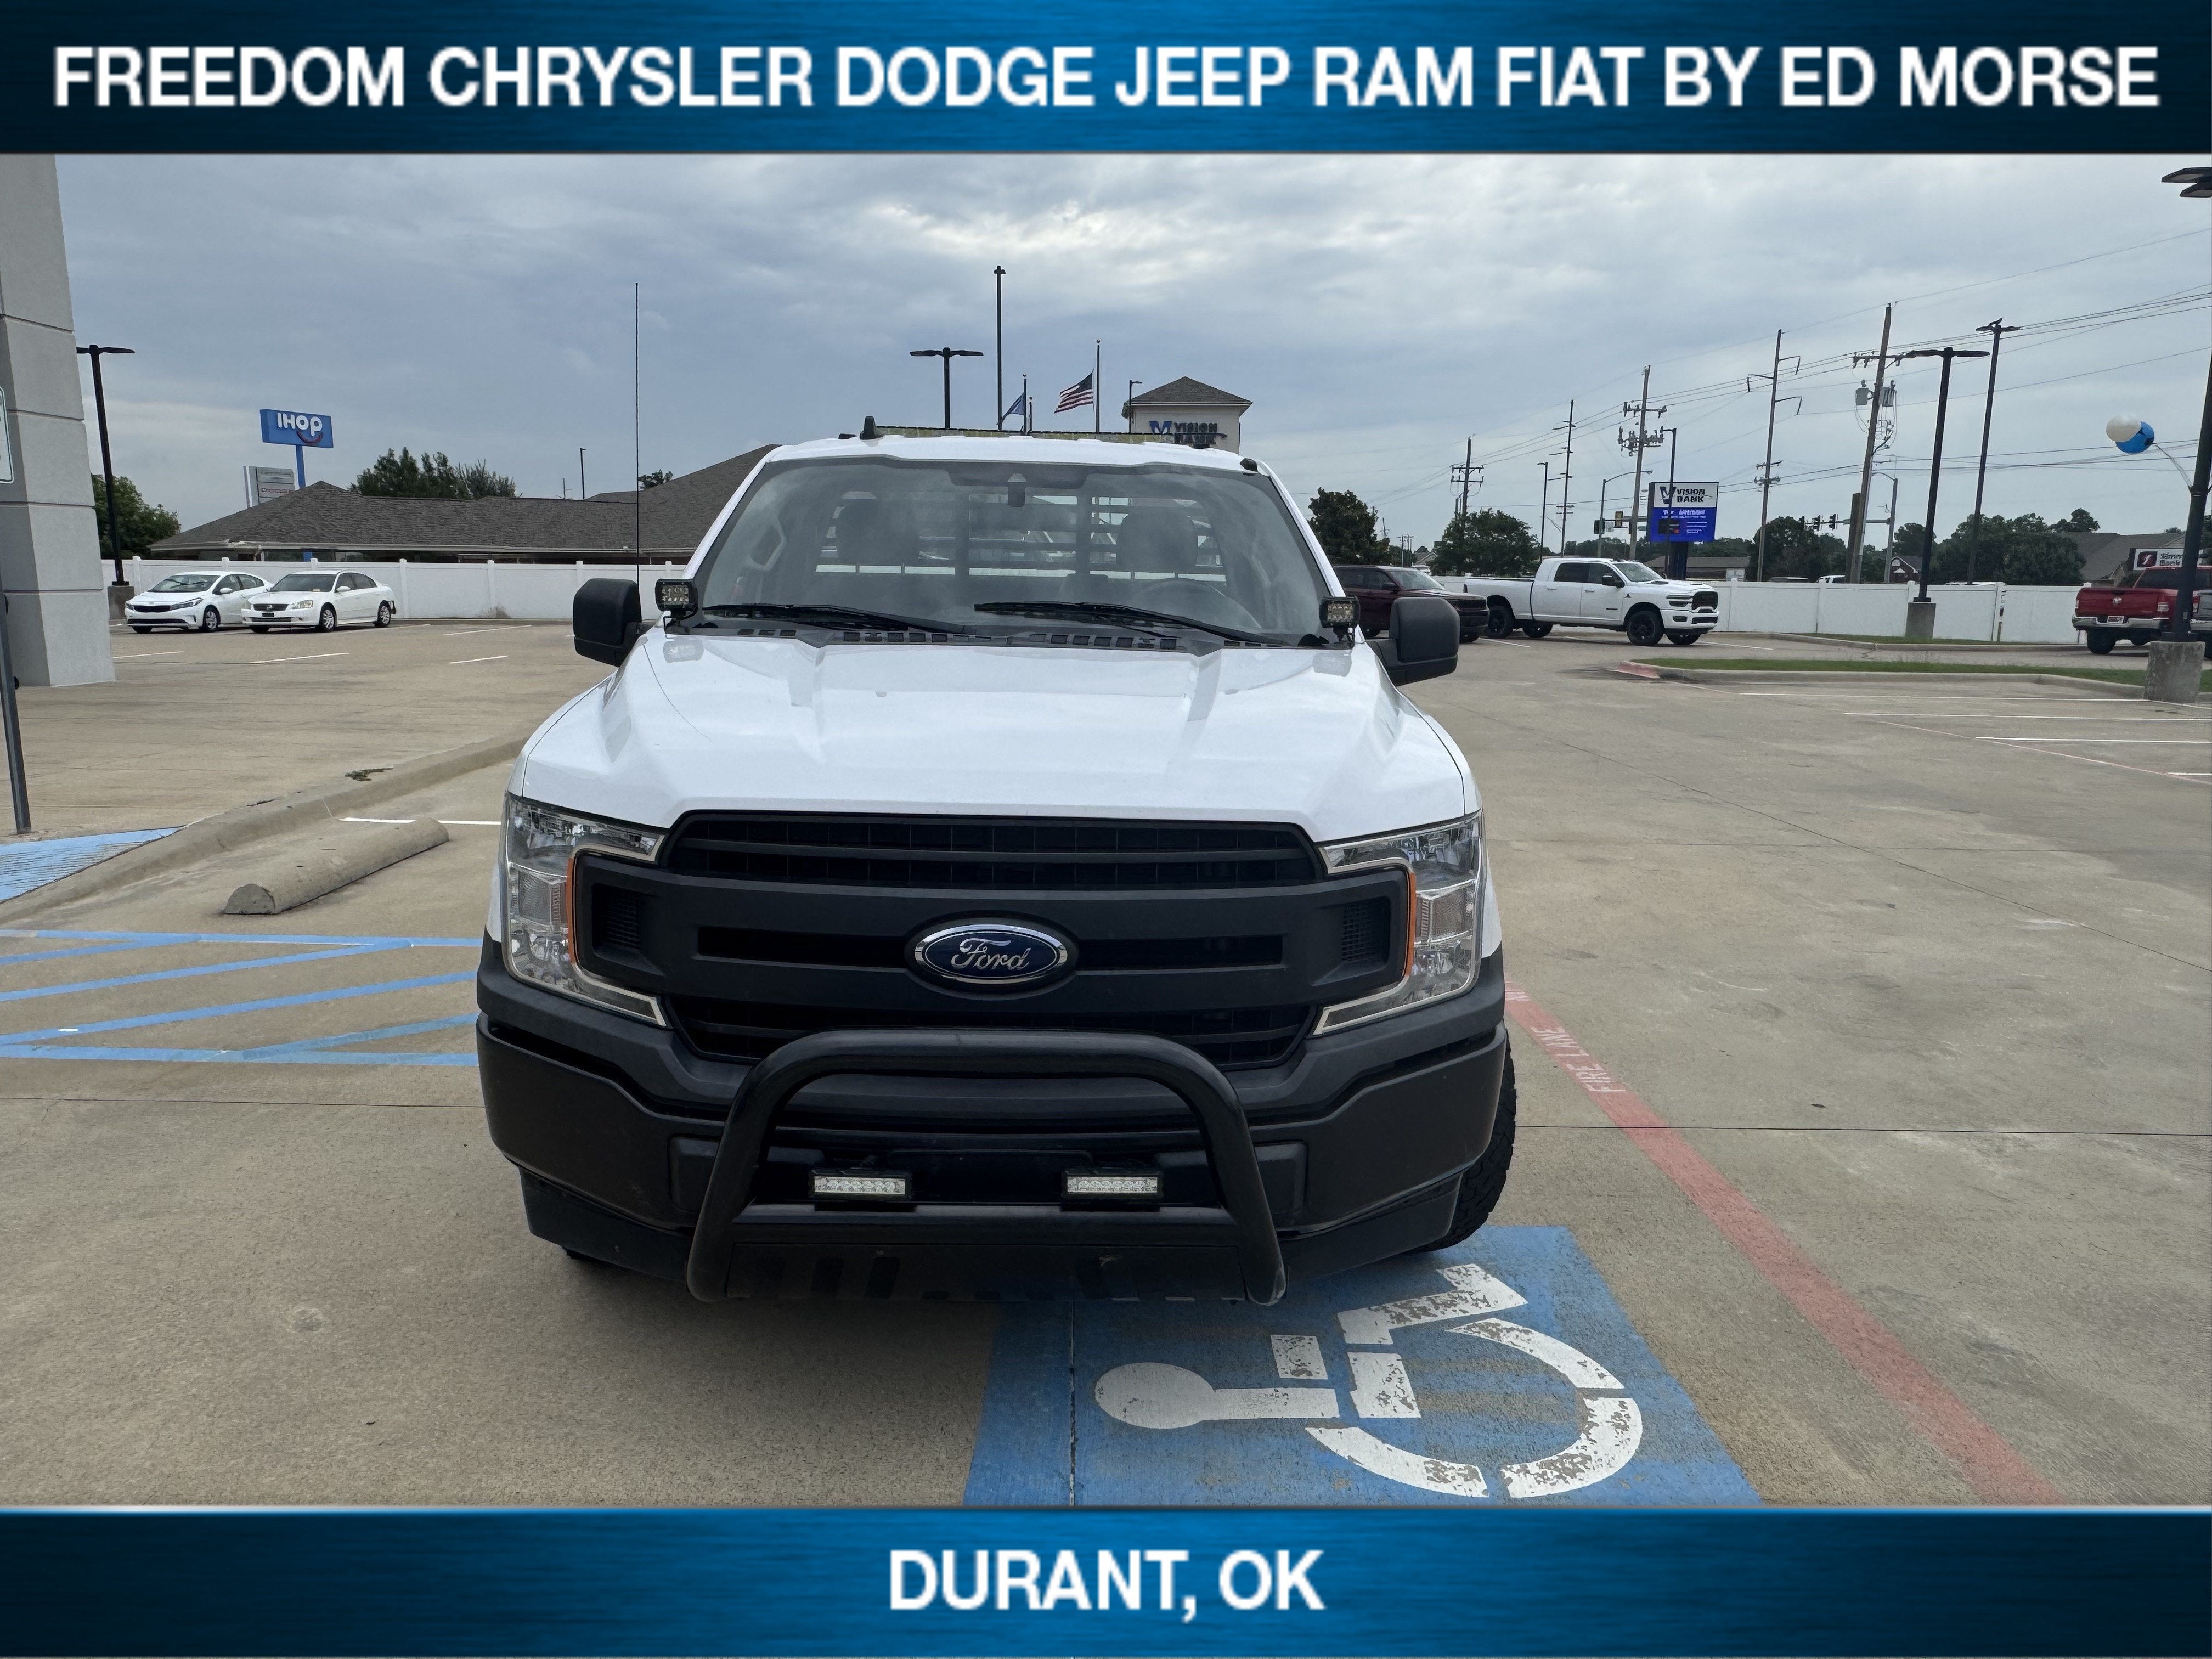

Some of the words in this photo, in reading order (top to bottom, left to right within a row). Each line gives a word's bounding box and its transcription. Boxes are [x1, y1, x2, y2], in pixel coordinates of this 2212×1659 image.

[278, 413, 323, 437] IHOP
[1174, 422, 1217, 433] VISION
[951, 937, 1032, 970] Ford
[1531, 1026, 1589, 1057] LANE
[1566, 1063, 1628, 1093] FIRE
